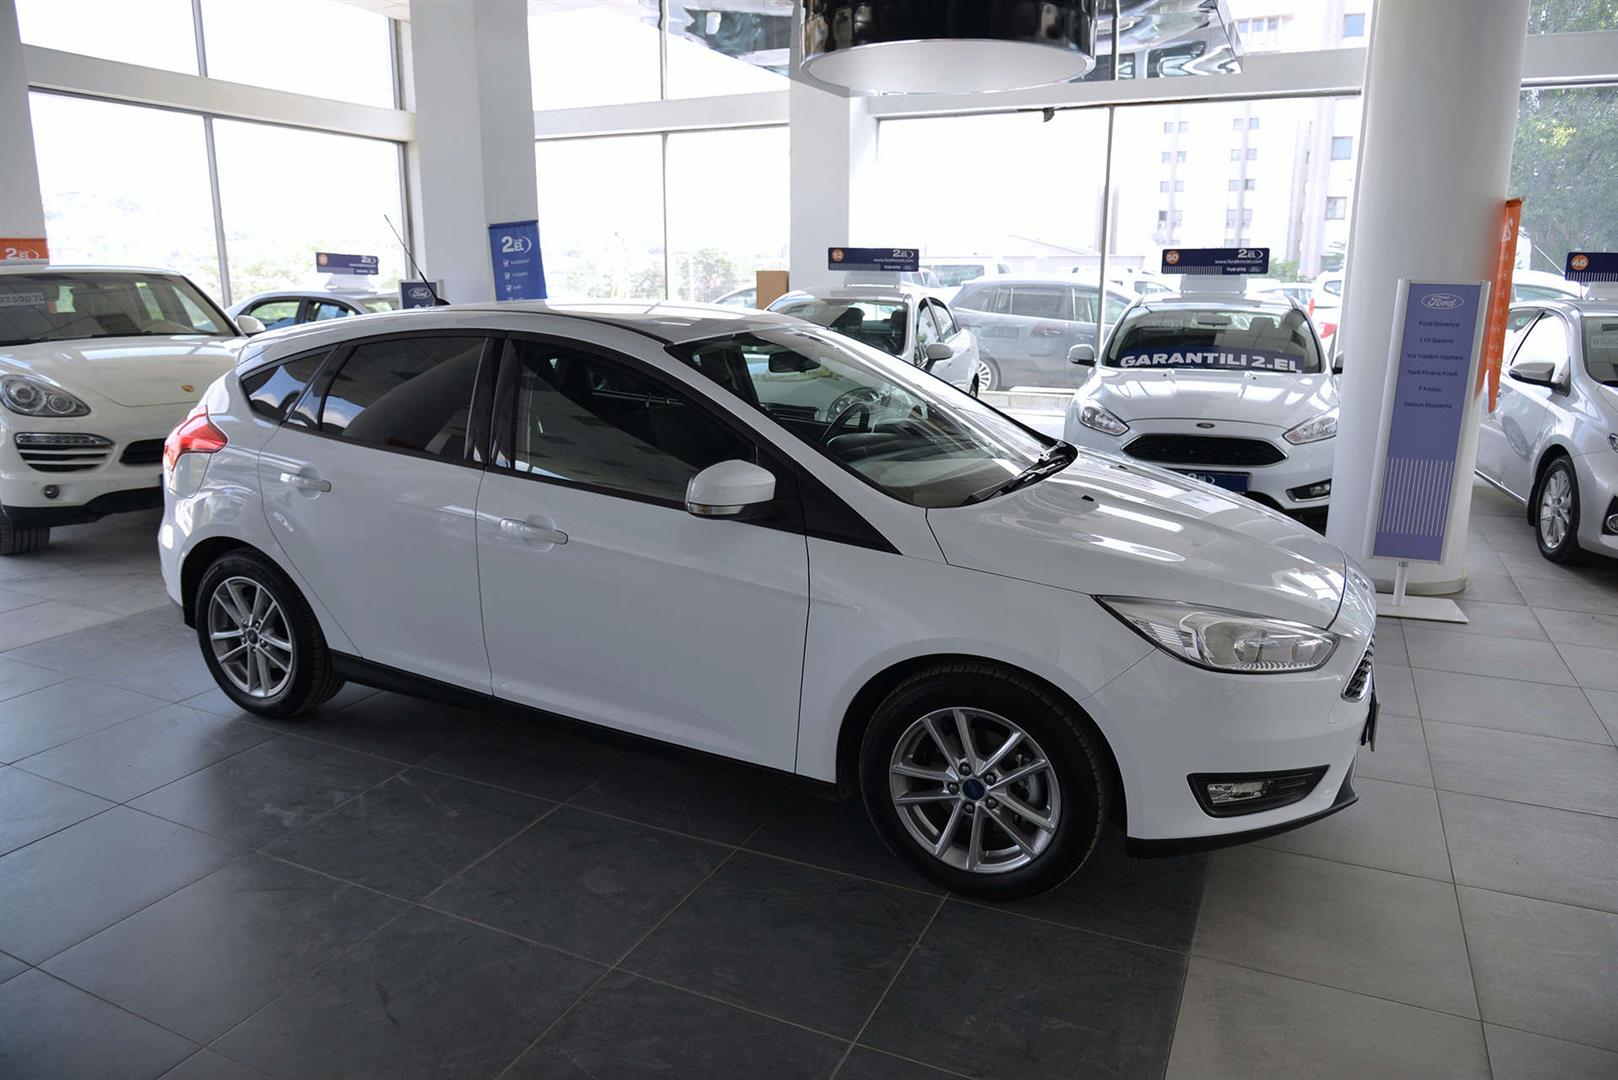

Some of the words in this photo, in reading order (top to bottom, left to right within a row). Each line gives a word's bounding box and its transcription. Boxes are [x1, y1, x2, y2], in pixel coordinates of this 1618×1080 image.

[1571, 258, 1586, 267] 46
[1427, 295, 1457, 307] Ford
[1251, 355, 1302, 373] 2.EL
